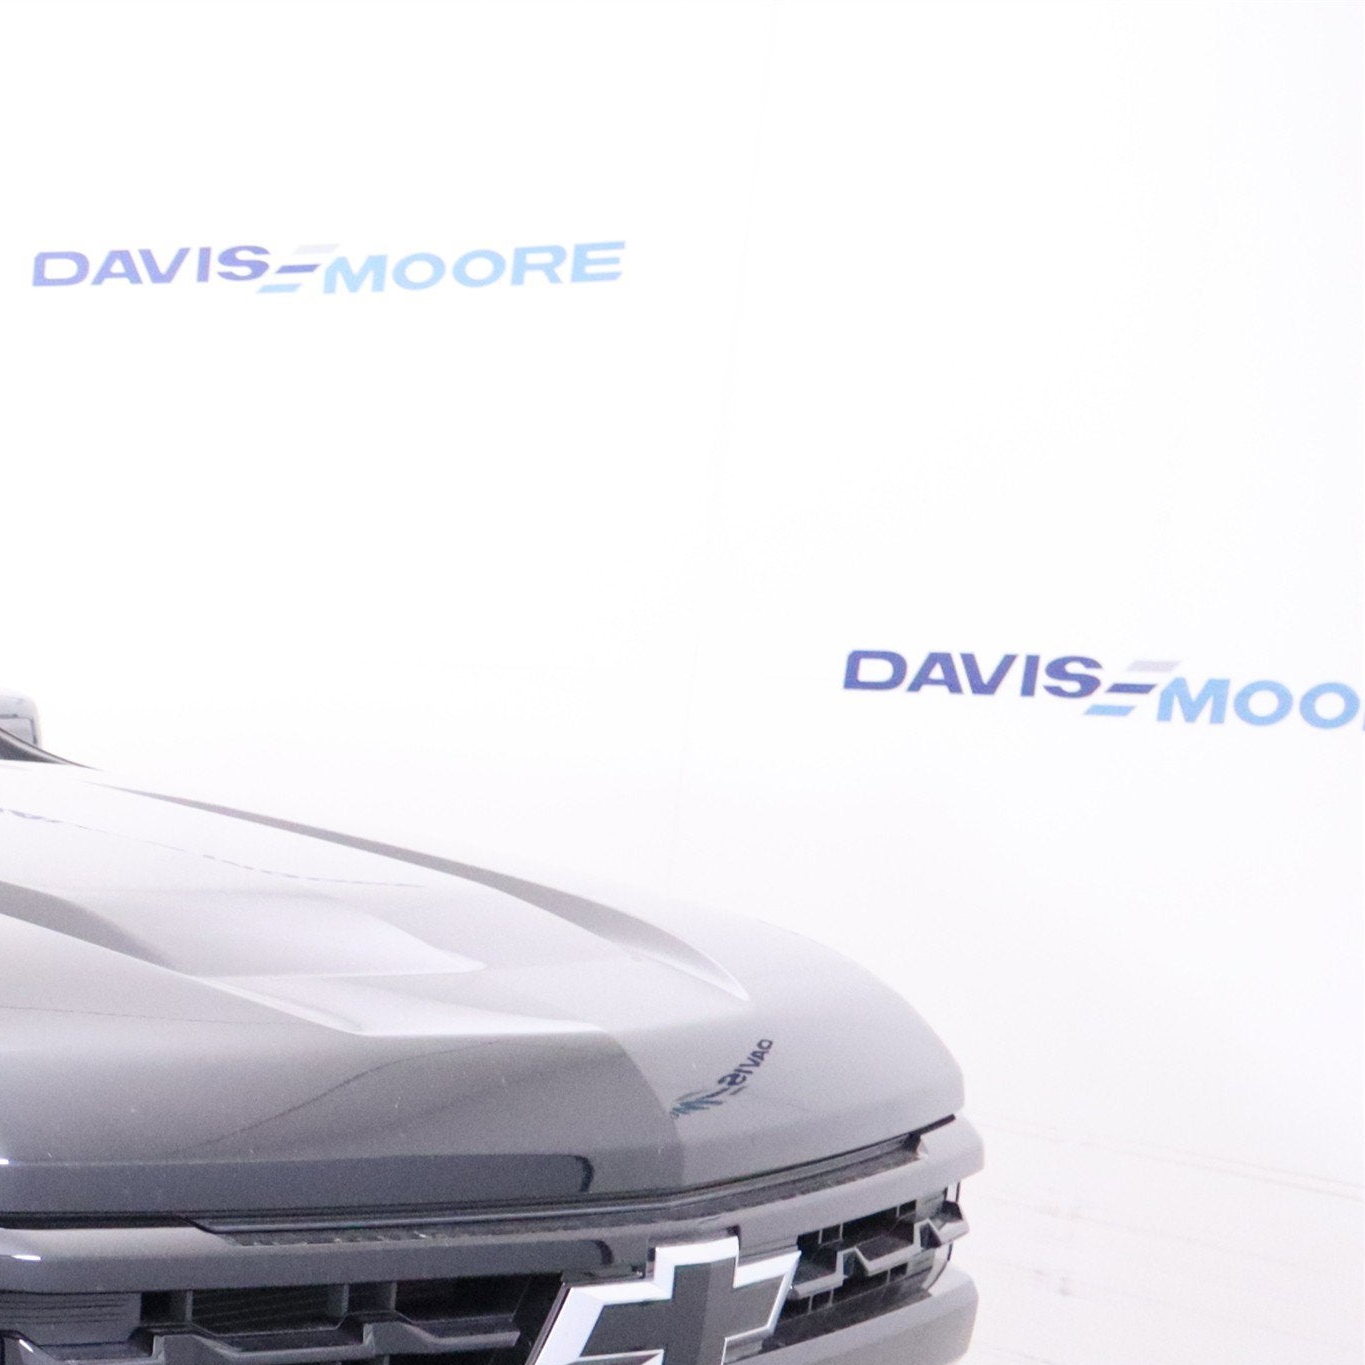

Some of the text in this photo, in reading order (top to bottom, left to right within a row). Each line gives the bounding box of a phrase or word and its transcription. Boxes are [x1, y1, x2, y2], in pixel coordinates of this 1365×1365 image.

[31, 241, 627, 295] DAVIS MOORE
[843, 649, 1365, 732] DAVIS MOO
